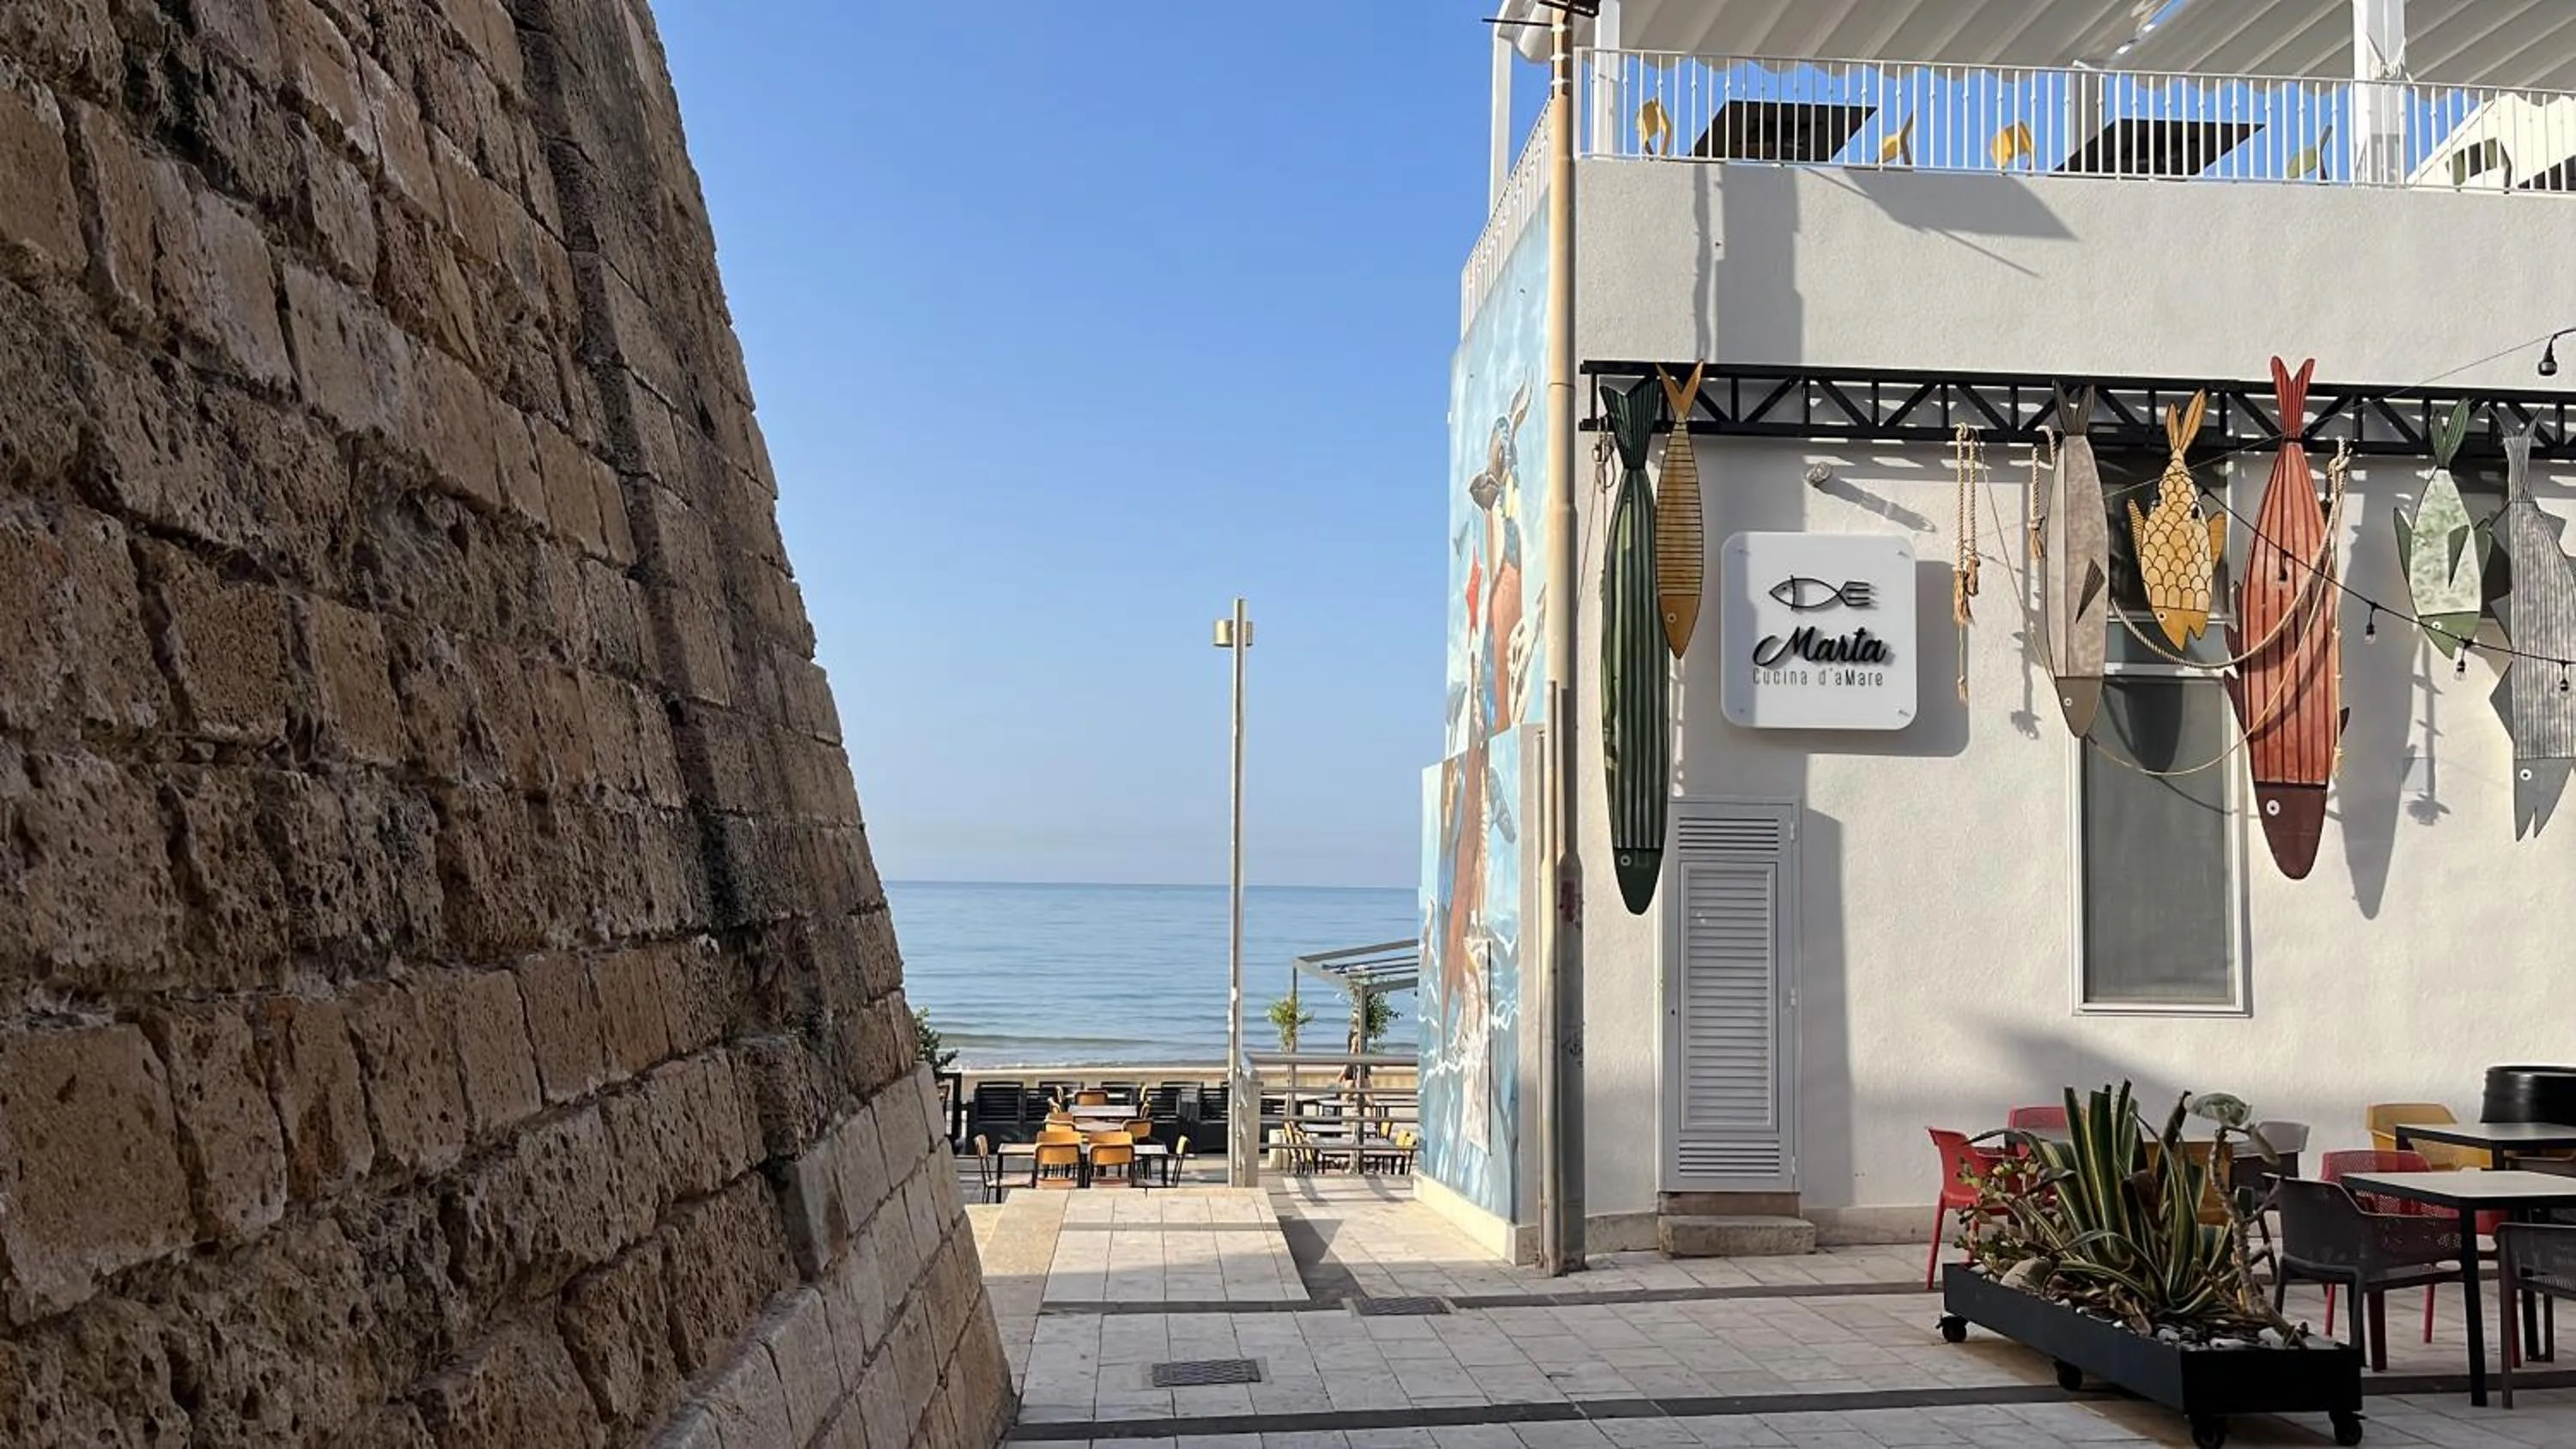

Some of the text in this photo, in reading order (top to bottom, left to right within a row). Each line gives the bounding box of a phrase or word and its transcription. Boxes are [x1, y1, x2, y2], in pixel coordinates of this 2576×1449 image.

[1753, 626, 1887, 666] Marta
[1753, 667, 1884, 687] Cucina d'aMare
